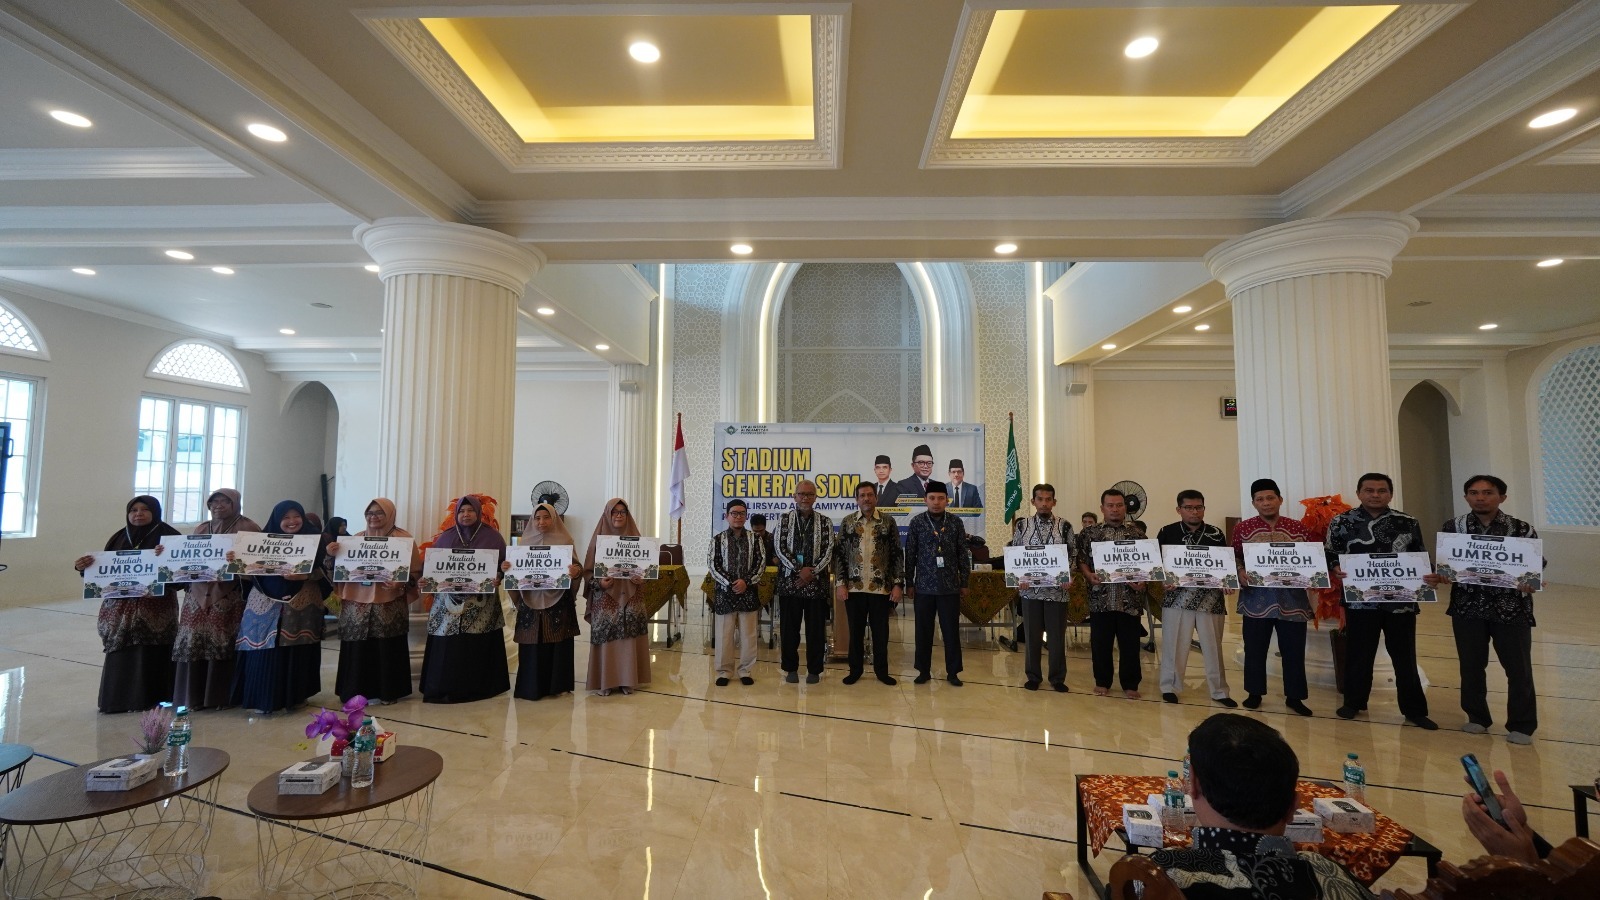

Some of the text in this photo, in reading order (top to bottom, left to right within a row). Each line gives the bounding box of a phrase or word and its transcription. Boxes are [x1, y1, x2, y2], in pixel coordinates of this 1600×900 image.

[722, 447, 811, 471] STADIUM
[815, 474, 860, 498] SDM
[262, 538, 293, 546] Hadiah
[1467, 542, 1506, 551] Hadiah
[170, 548, 224, 558] UMROH
[247, 544, 304, 554] UMROH
[606, 548, 650, 558] UMROH
[348, 550, 400, 559] UMROH
[1104, 552, 1150, 562] UMROH
[1452, 548, 1523, 563] UMROH
[112, 556, 142, 565] Hadiah
[516, 558, 562, 568] UMROH
[1014, 557, 1058, 566] UMROH
[1174, 558, 1224, 568] UMROH
[1257, 556, 1312, 564] UMROH
[98, 564, 154, 574] UMROH
[436, 562, 486, 571] UMROH
[1355, 568, 1417, 578] UMROH
